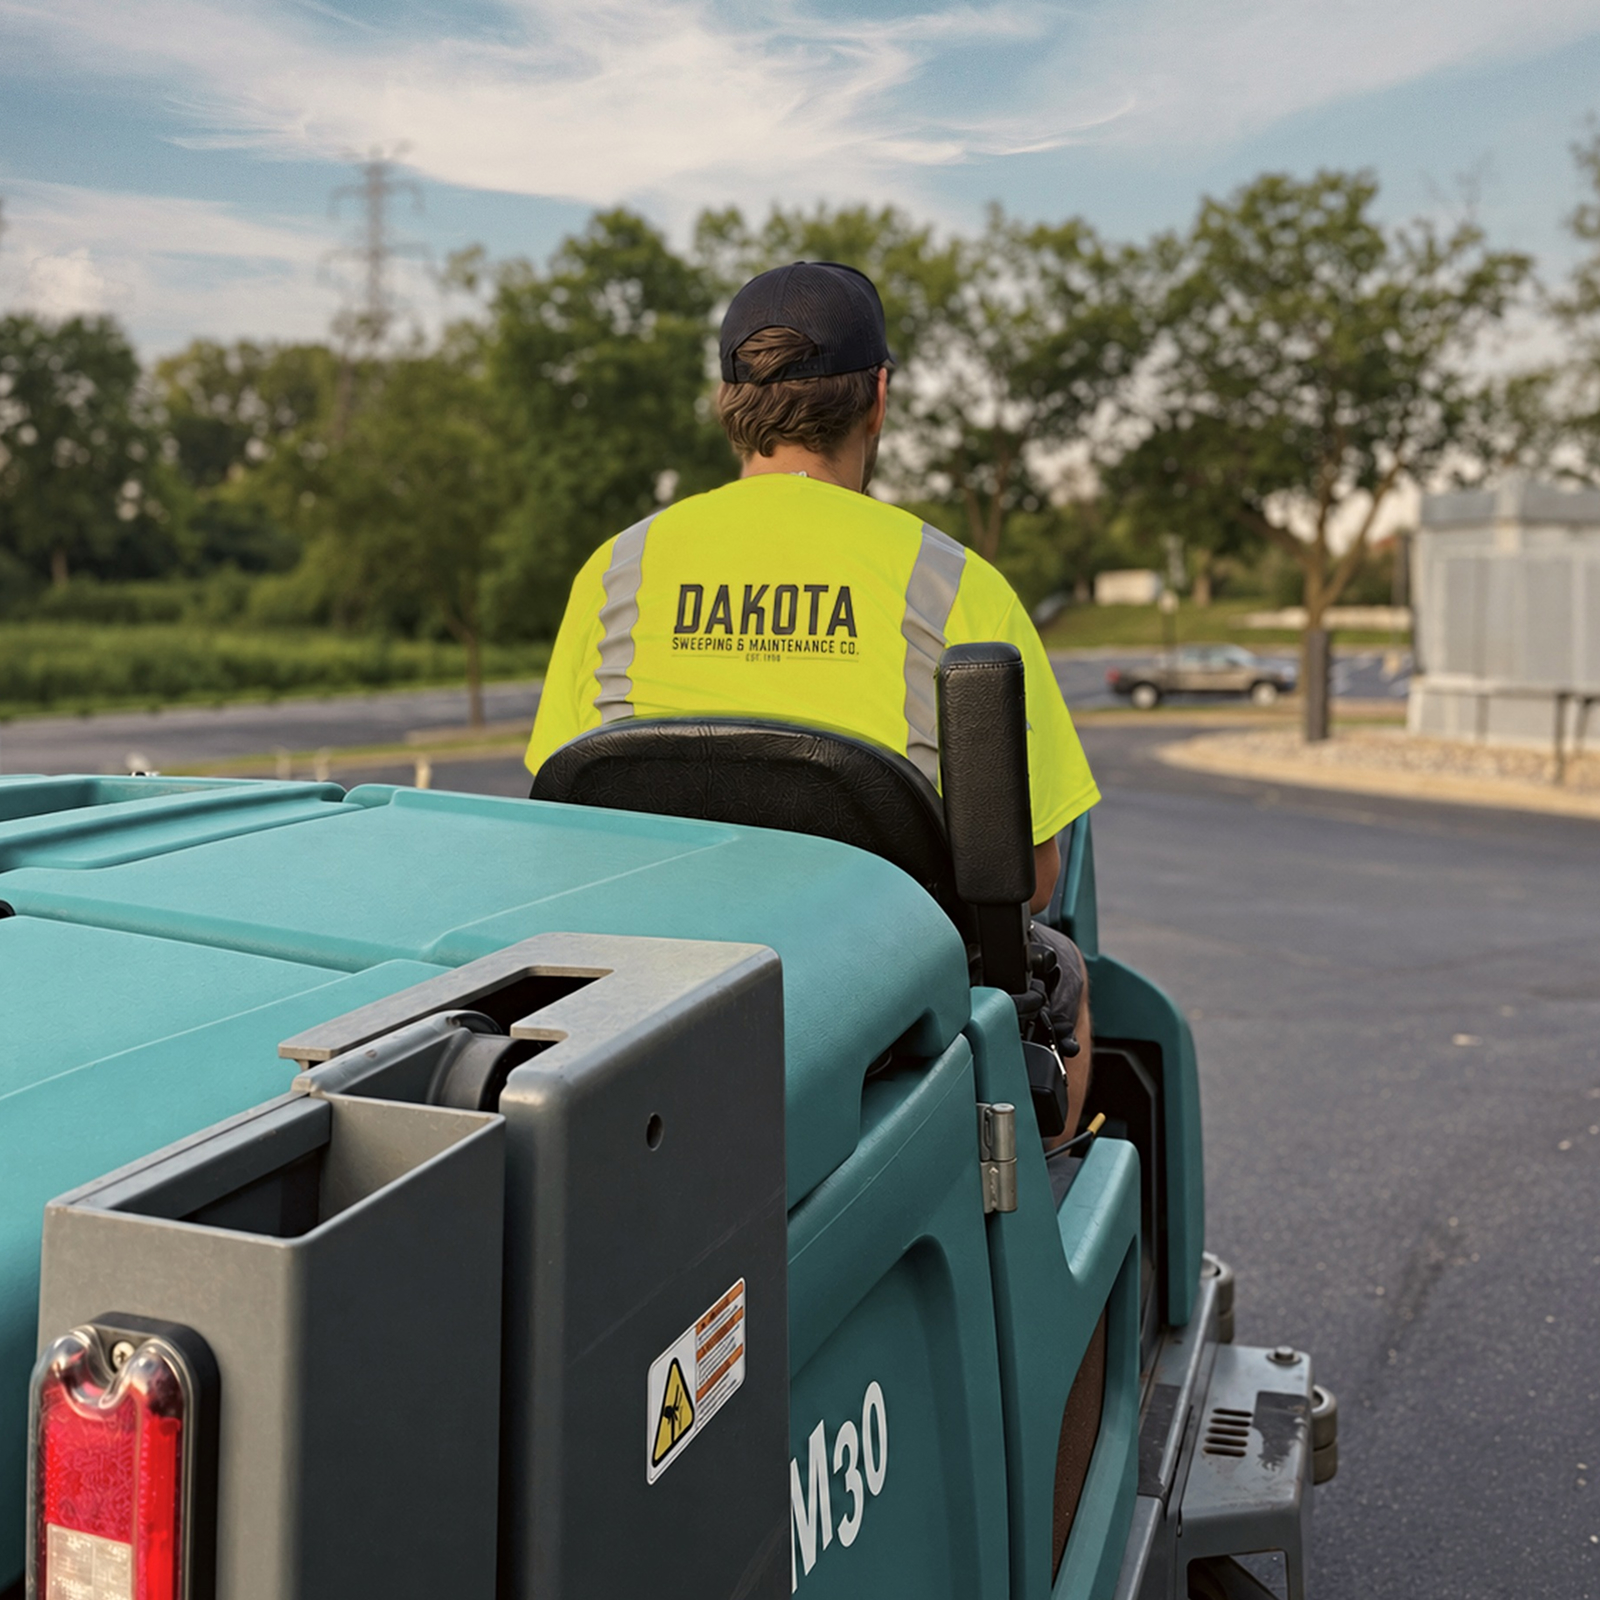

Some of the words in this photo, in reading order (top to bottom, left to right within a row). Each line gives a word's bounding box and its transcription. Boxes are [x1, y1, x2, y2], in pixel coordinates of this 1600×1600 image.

[673, 584, 858, 638] DAKOTA
[672, 636, 732, 651] SWEEPING
[750, 638, 835, 654] MAINTENANCE
[840, 640, 859, 655] CO.
[790, 1380, 888, 1595] M30
